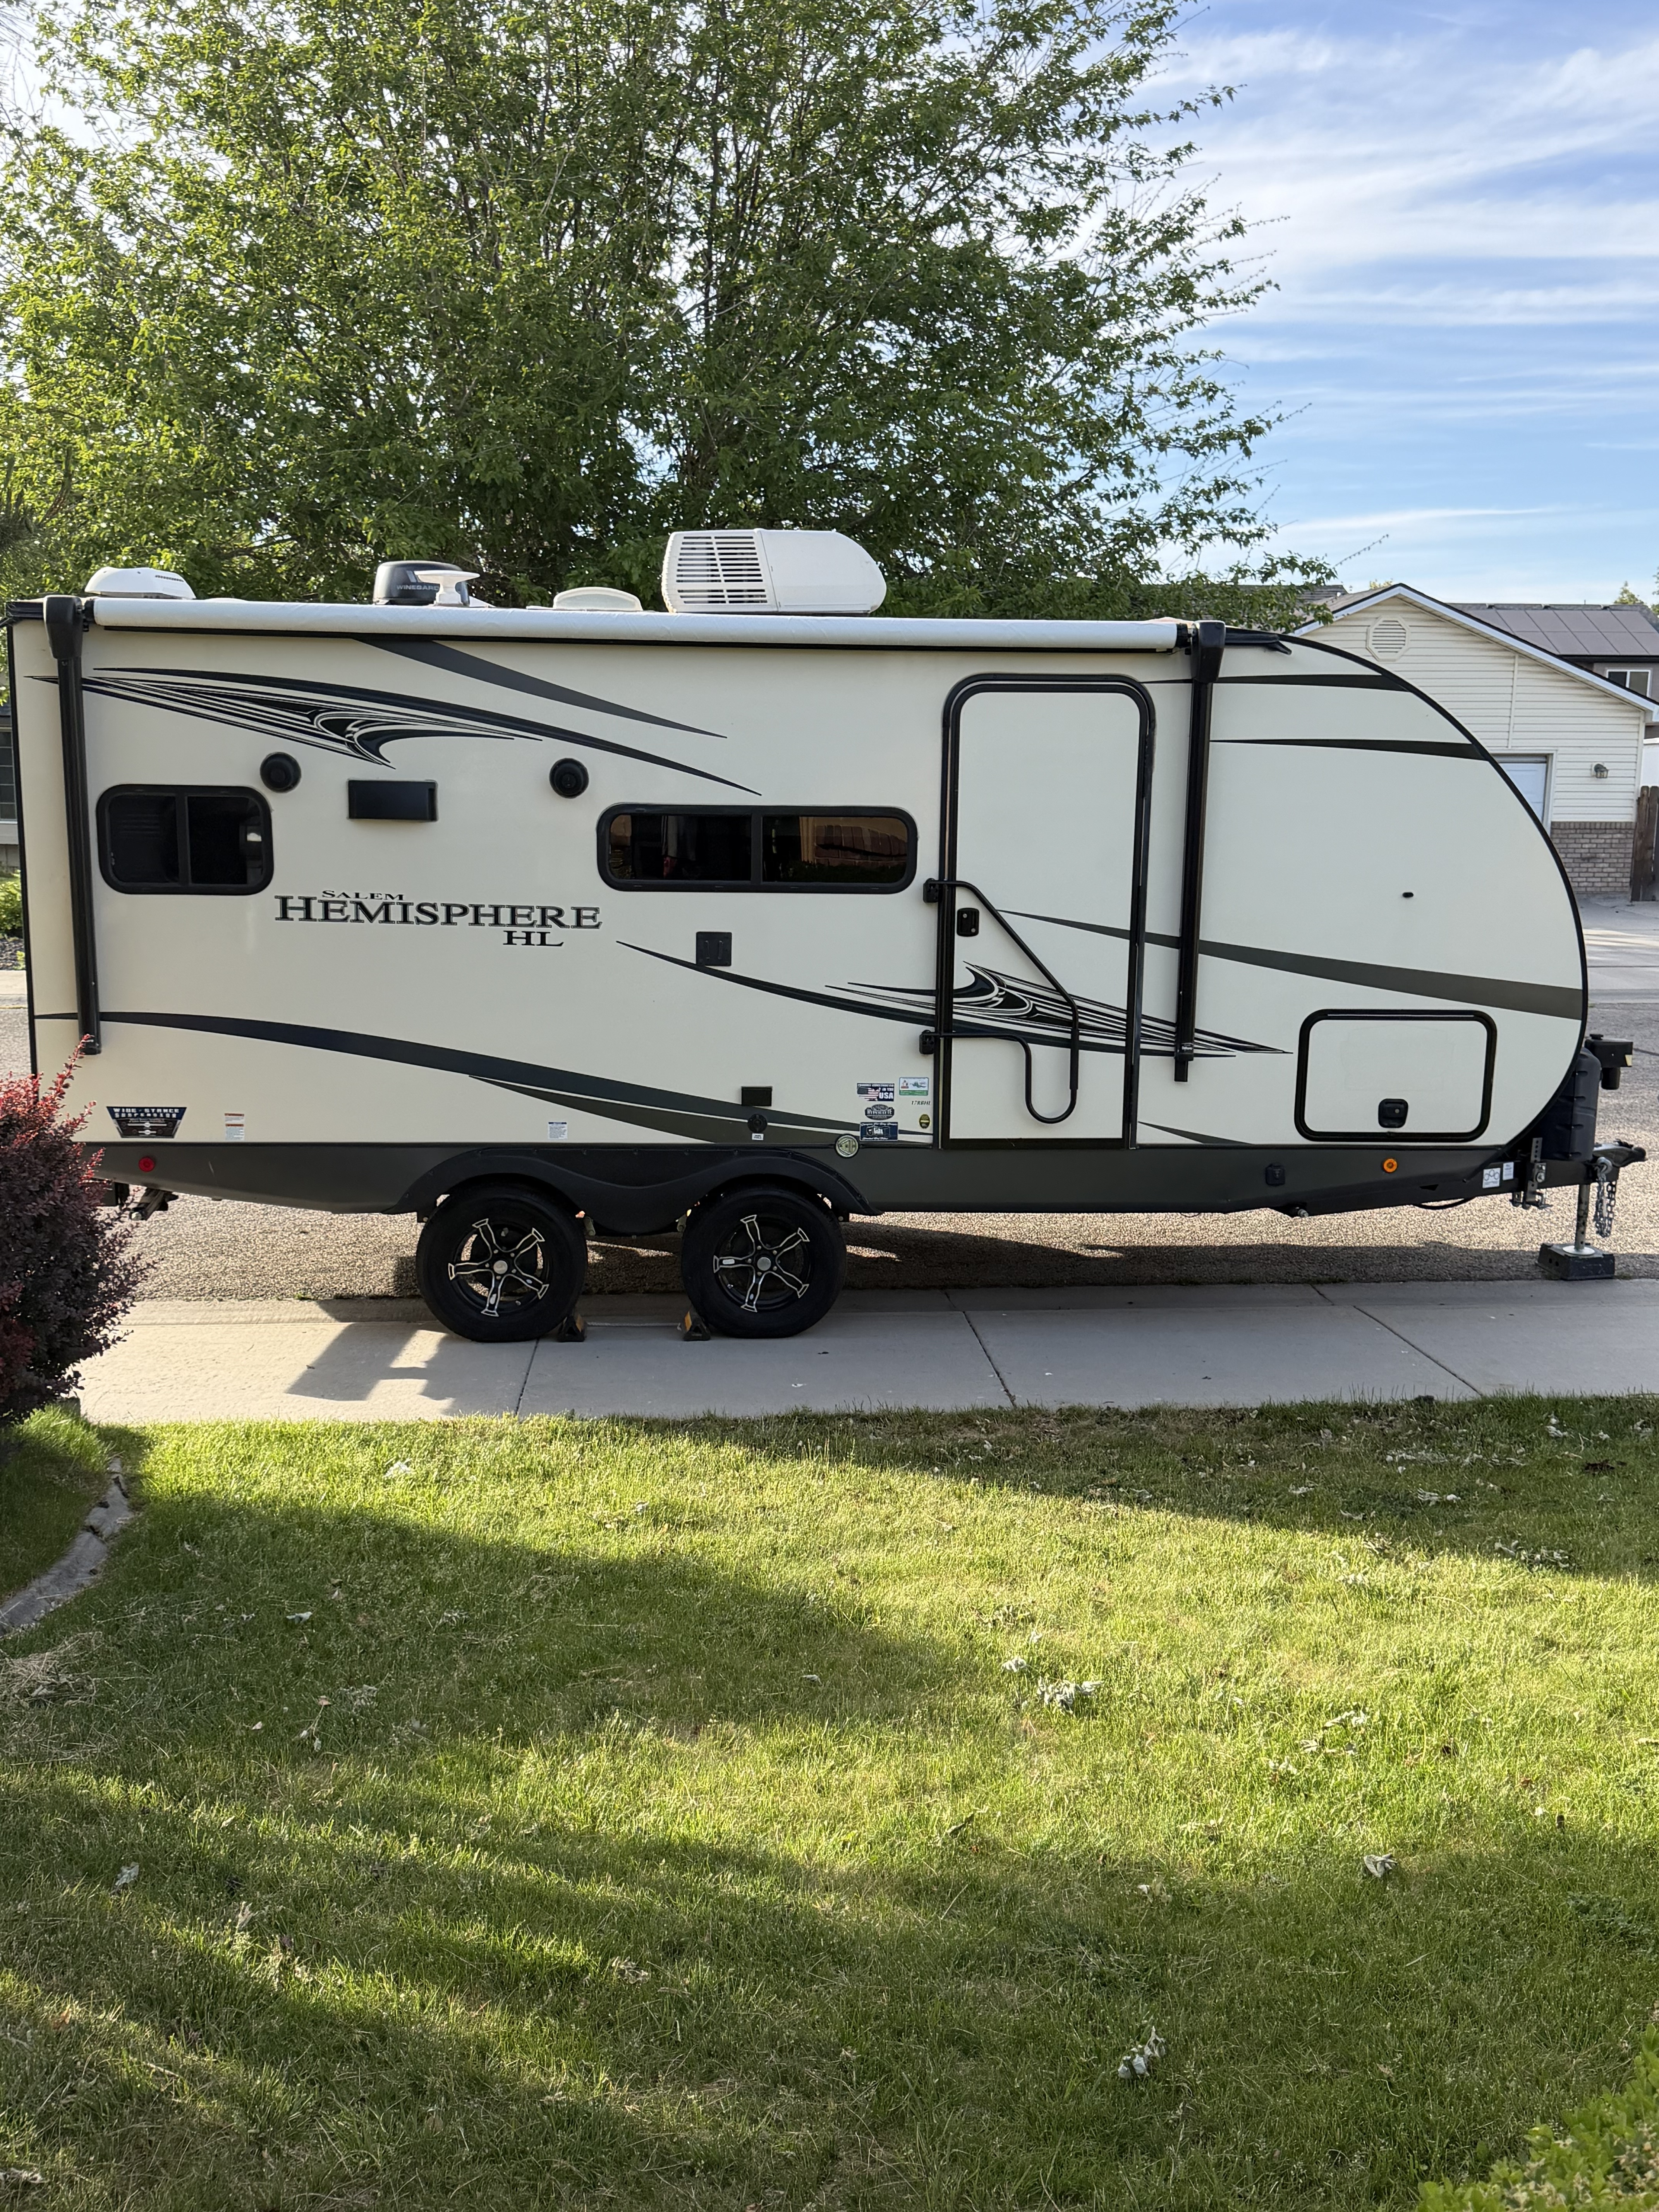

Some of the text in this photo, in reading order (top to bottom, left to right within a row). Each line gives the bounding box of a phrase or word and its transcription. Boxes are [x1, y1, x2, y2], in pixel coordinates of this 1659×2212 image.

[322, 890, 404, 900] SALEM
[275, 895, 603, 929] HEMISPHERE
[503, 930, 564, 947] HL
